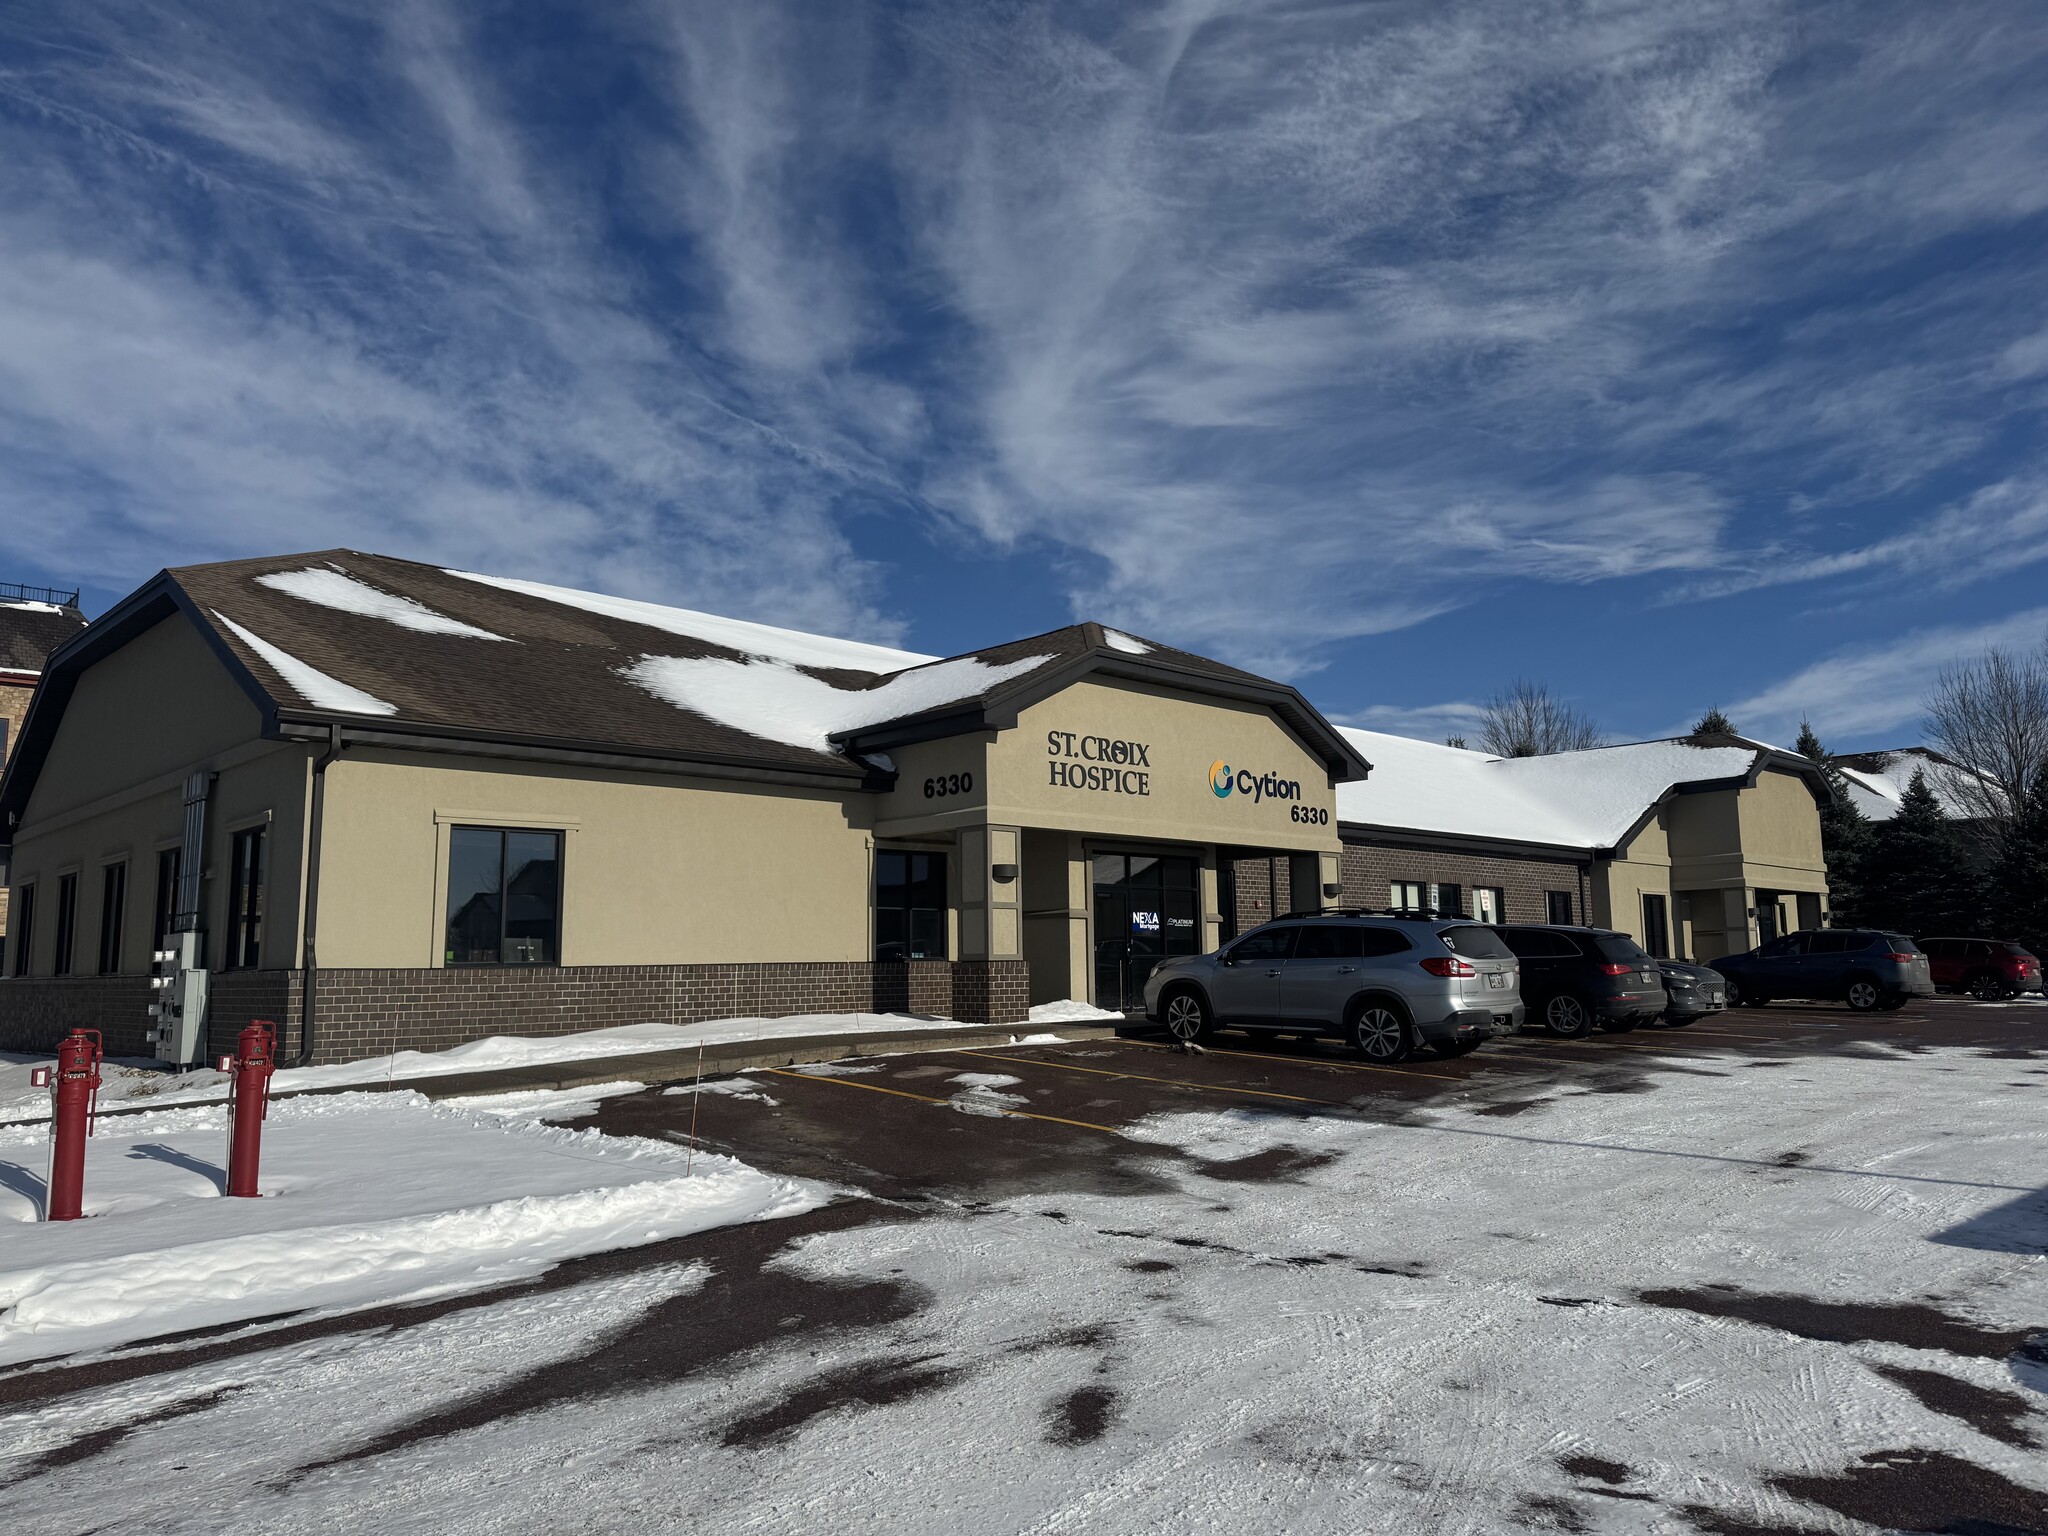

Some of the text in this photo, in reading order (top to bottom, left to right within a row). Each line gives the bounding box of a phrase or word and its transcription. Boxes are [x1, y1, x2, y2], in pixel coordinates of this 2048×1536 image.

[1047, 730, 1150, 768] ST. CROIX
[923, 772, 973, 799] 6330
[1048, 760, 1150, 796] HOSPICE
[1236, 769, 1301, 804] Cytion
[1290, 804, 1329, 825] 6330
[1132, 912, 1159, 923] NEXA
